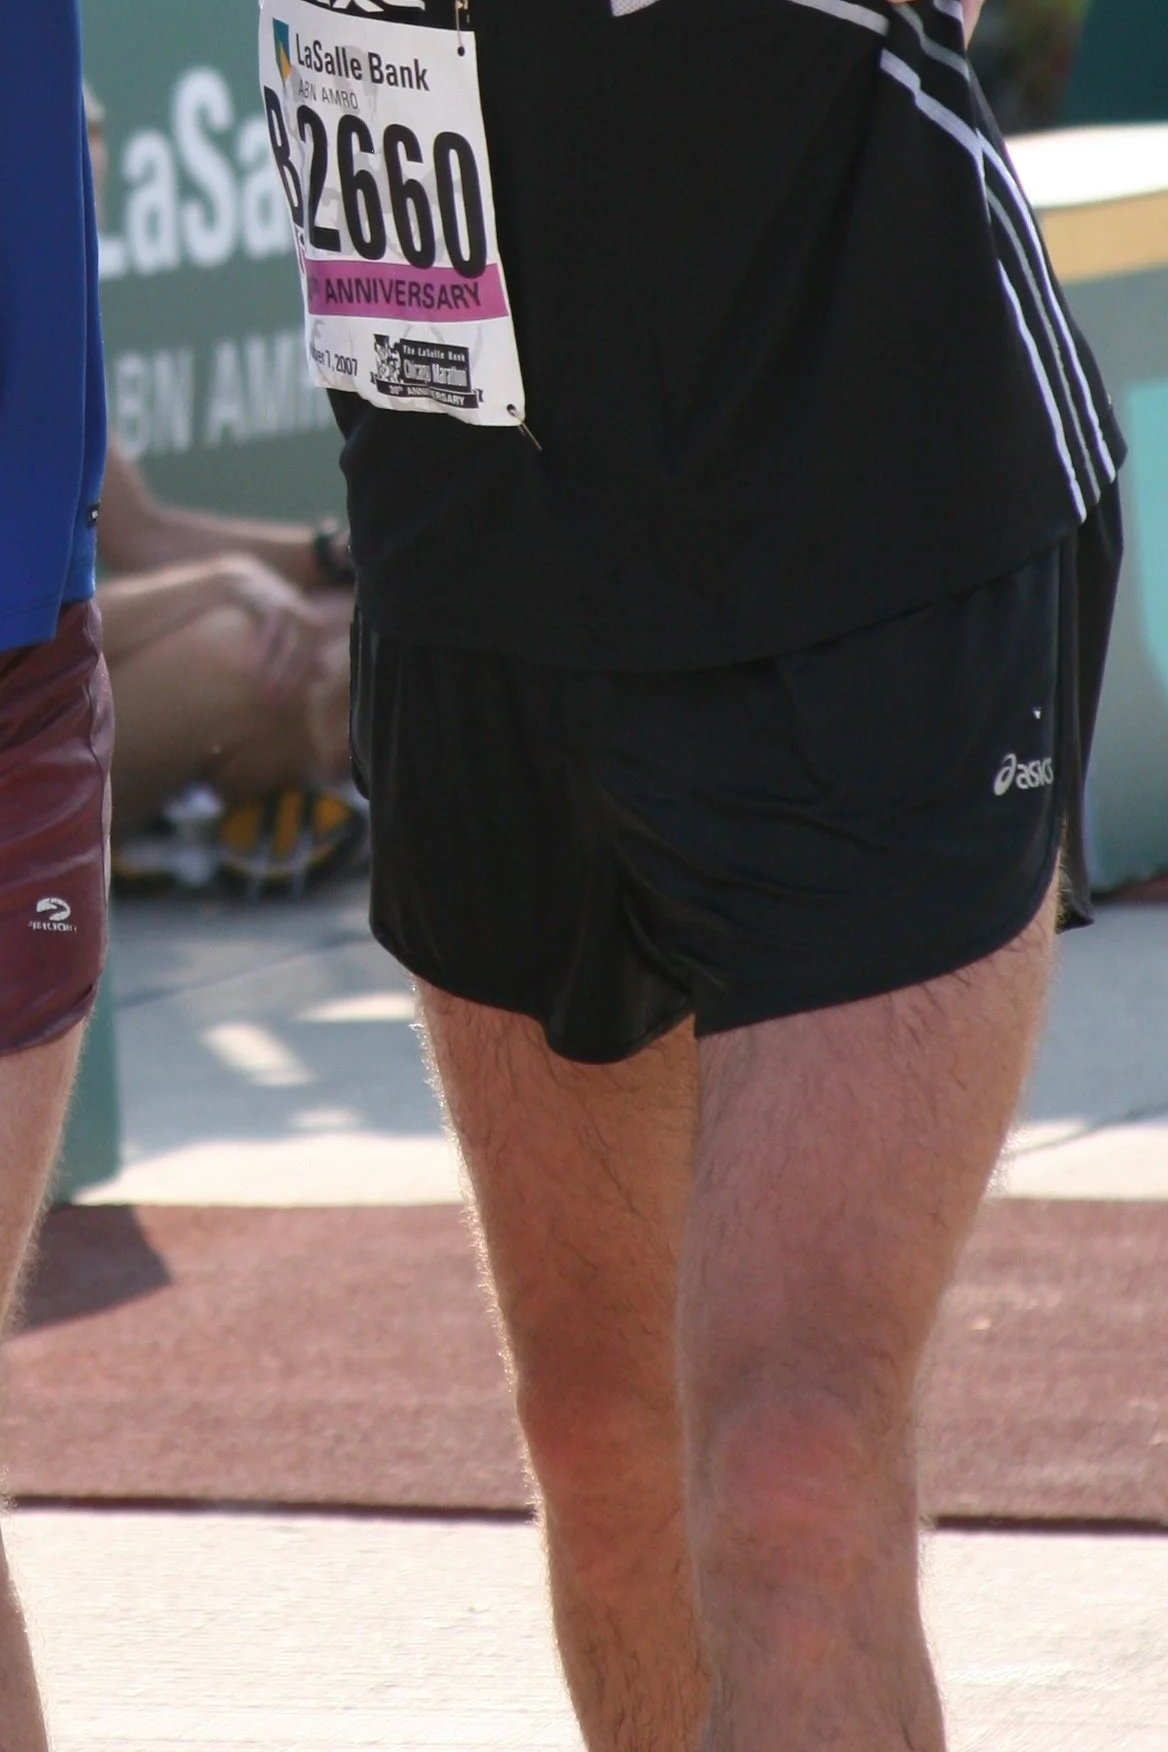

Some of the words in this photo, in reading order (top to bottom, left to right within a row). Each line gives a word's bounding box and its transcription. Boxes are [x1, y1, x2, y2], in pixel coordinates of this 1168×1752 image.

[296, 33, 363, 81] LaSalle
[368, 51, 431, 92] Bank
[298, 79, 317, 102] ABN
[322, 88, 359, 110] AMRO
[297, 104, 487, 280] 2660
[325, 278, 482, 311] ANNIVERSARY
[335, 353, 358, 377] 2007
